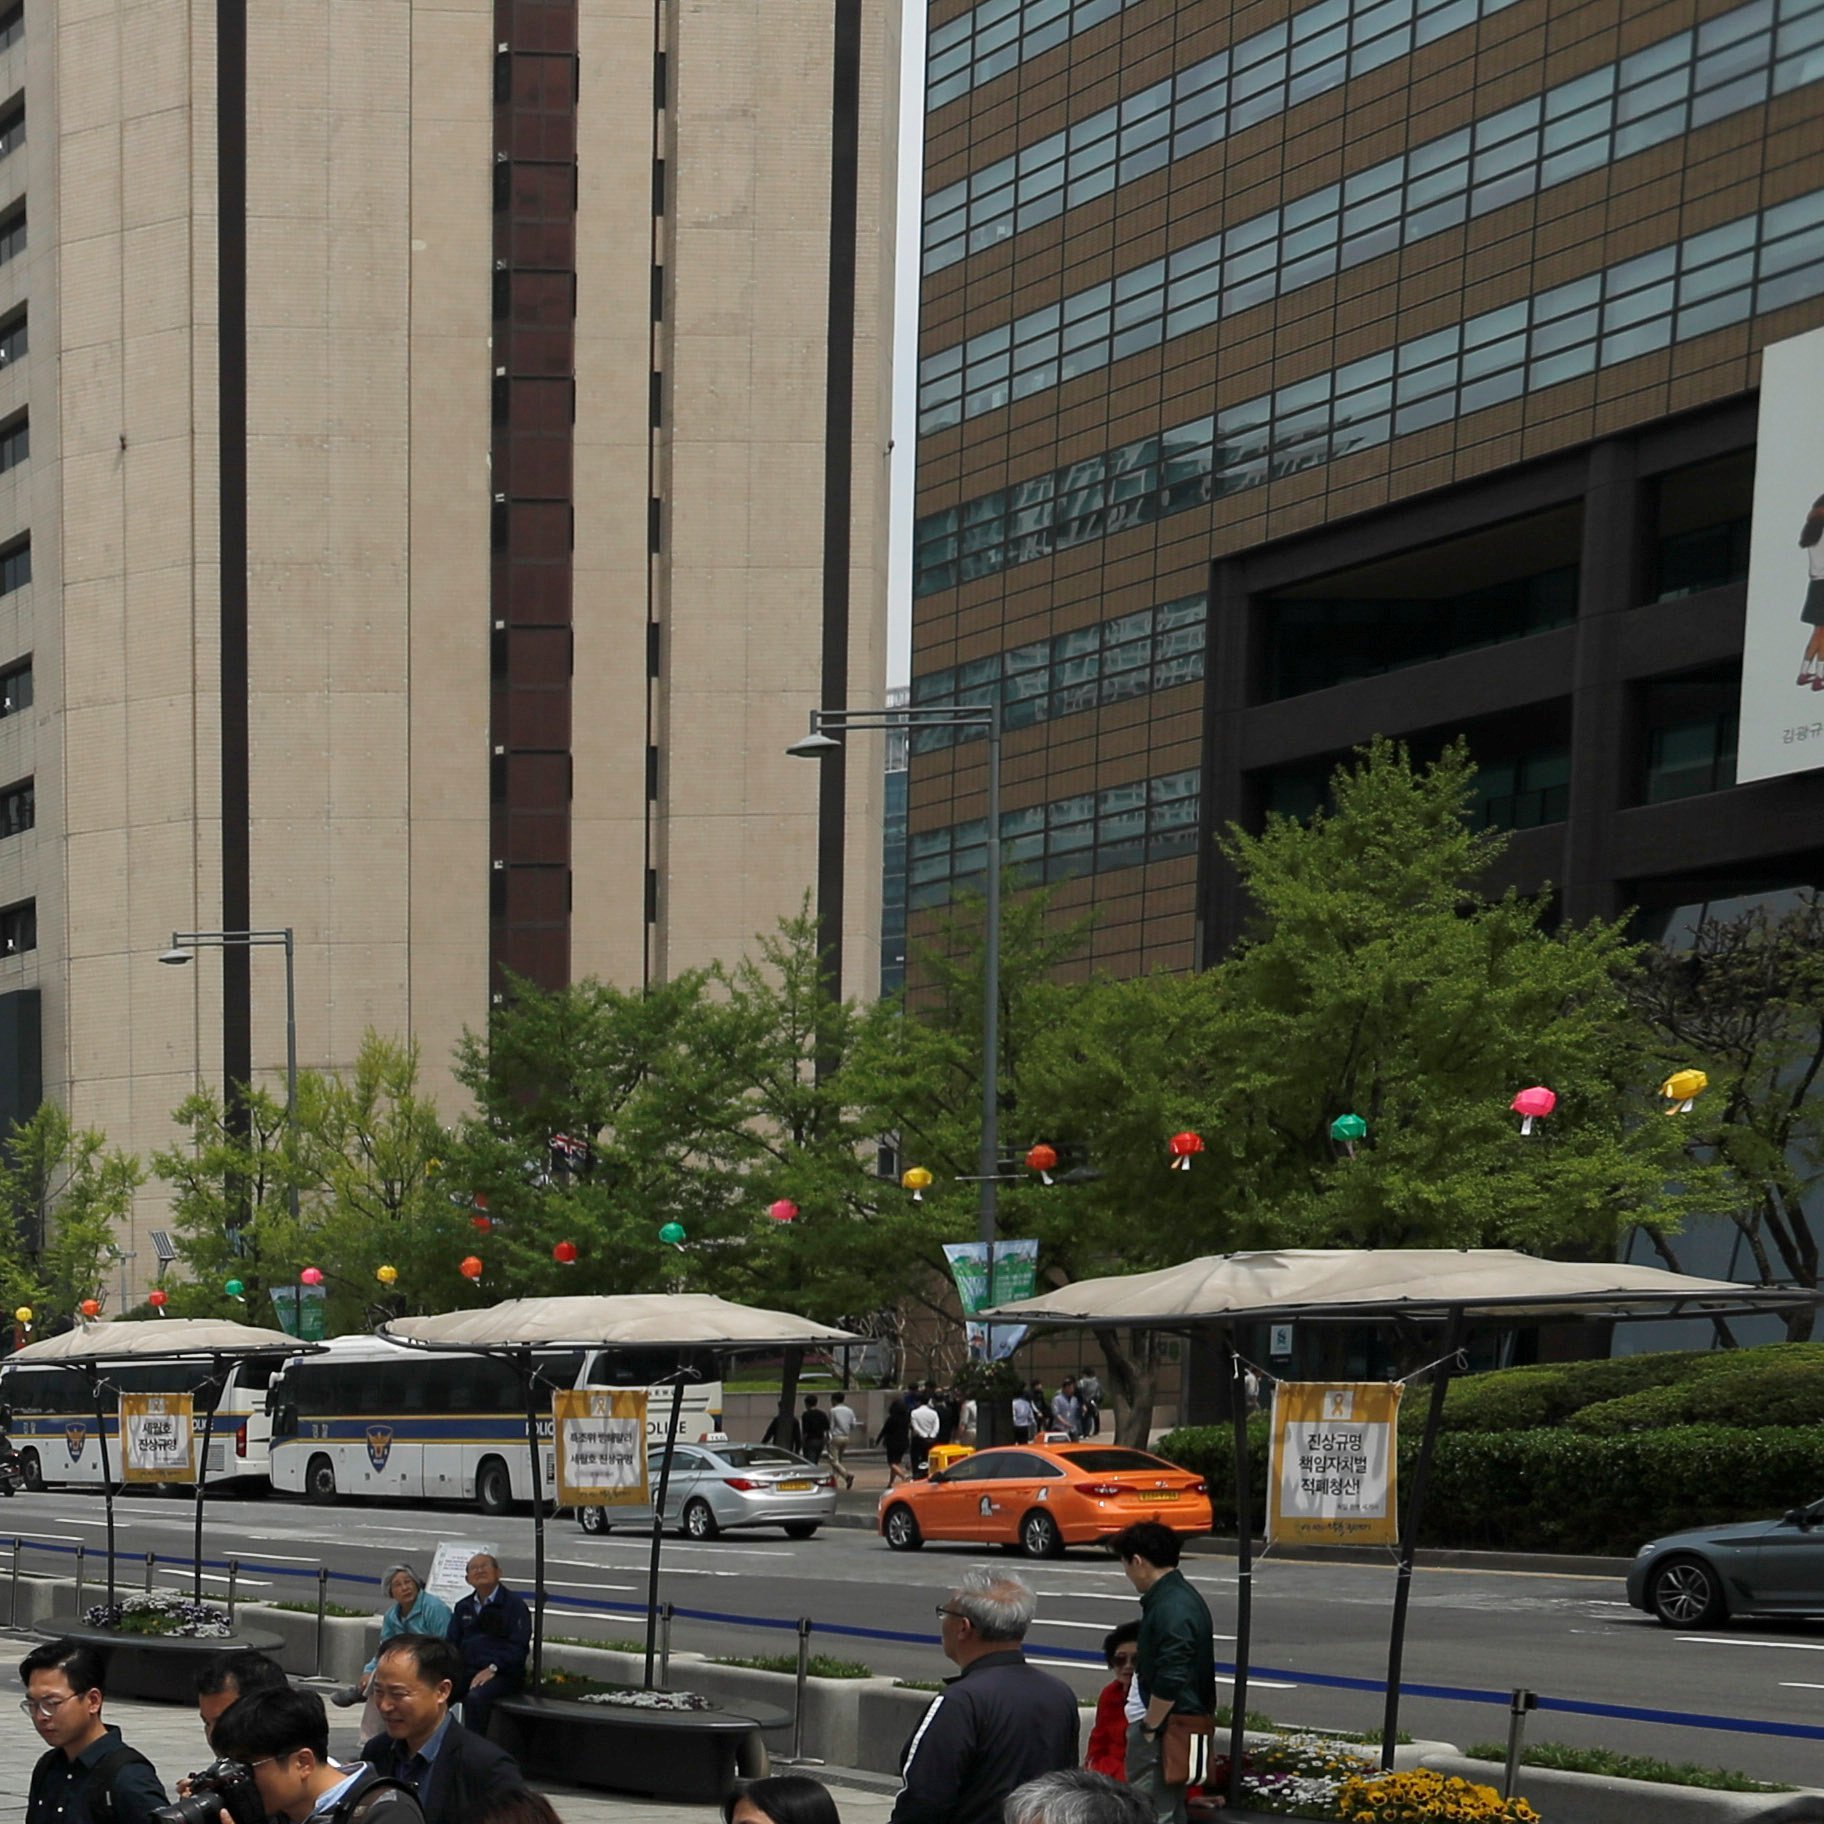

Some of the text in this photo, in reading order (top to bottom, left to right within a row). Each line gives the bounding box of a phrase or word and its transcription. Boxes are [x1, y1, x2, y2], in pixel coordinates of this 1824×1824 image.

[1308, 1433, 1362, 1451] 진상규명
[1299, 1456, 1367, 1474] 책임자처벌
[1301, 1478, 1360, 1496] 적폐청산!
